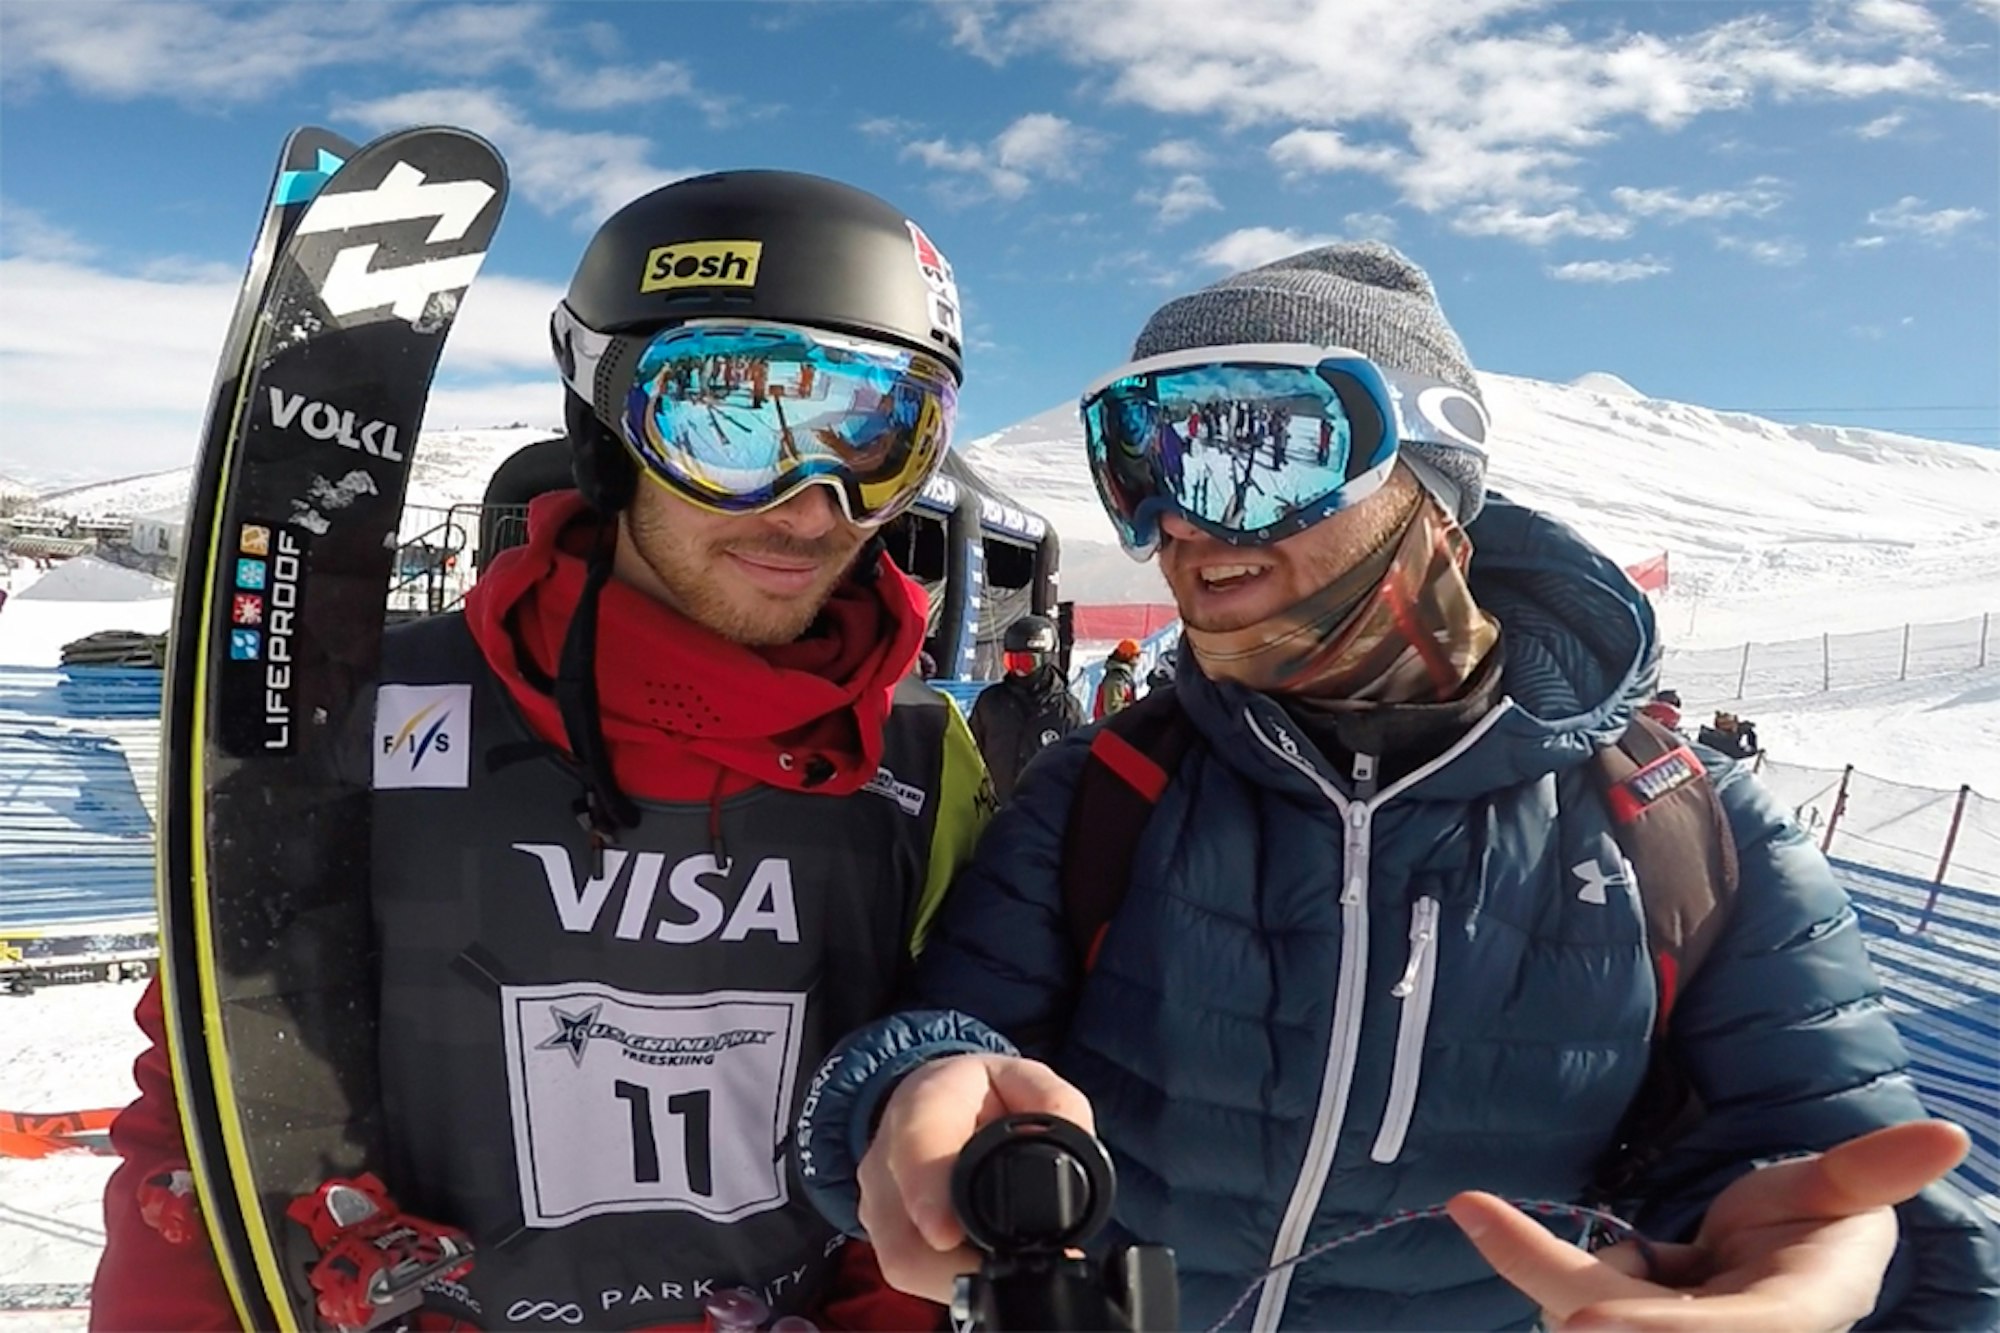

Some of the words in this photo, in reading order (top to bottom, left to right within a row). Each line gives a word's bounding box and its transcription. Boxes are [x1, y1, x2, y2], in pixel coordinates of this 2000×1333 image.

[651, 251, 749, 281] Sosh
[264, 529, 301, 749] LIFEPROOF
[383, 733, 450, 754] FIS
[512, 843, 800, 944] VISA
[622, 1048, 715, 1066] FREESKIING
[626, 1033, 716, 1053] GRAND
[614, 1078, 713, 1199] 11
[601, 1278, 714, 1310] PARK
[737, 1264, 807, 1307] ITY
